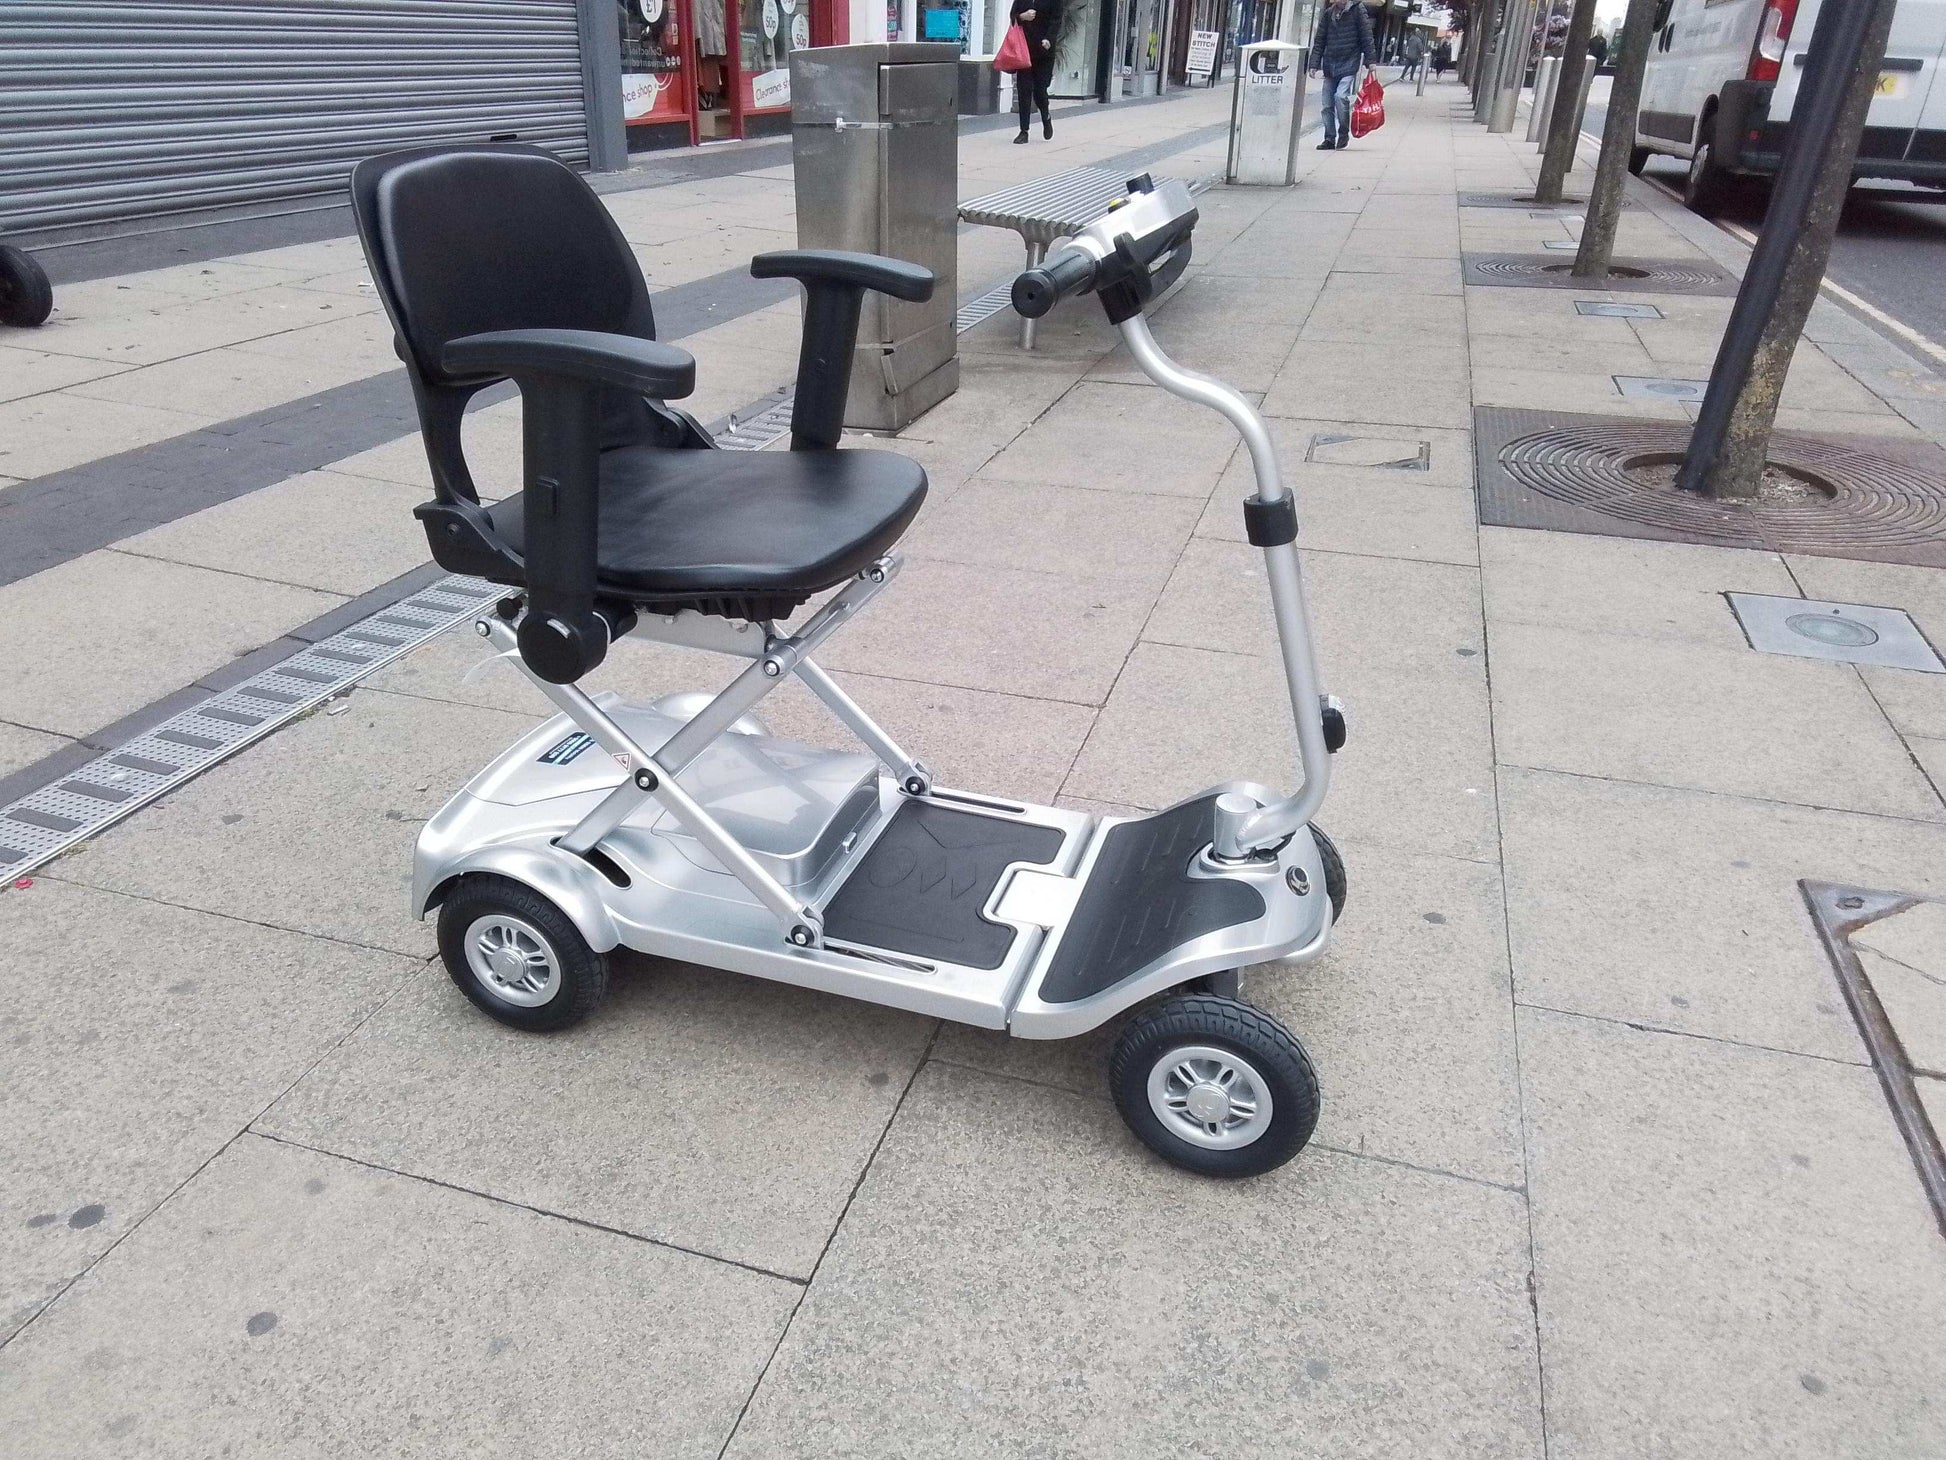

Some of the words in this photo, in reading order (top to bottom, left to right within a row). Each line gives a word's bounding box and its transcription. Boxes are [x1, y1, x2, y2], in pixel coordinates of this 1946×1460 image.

[1192, 40, 1216, 48] STITCH
[1252, 75, 1283, 84] LITTER
[637, 84, 652, 98] shop
